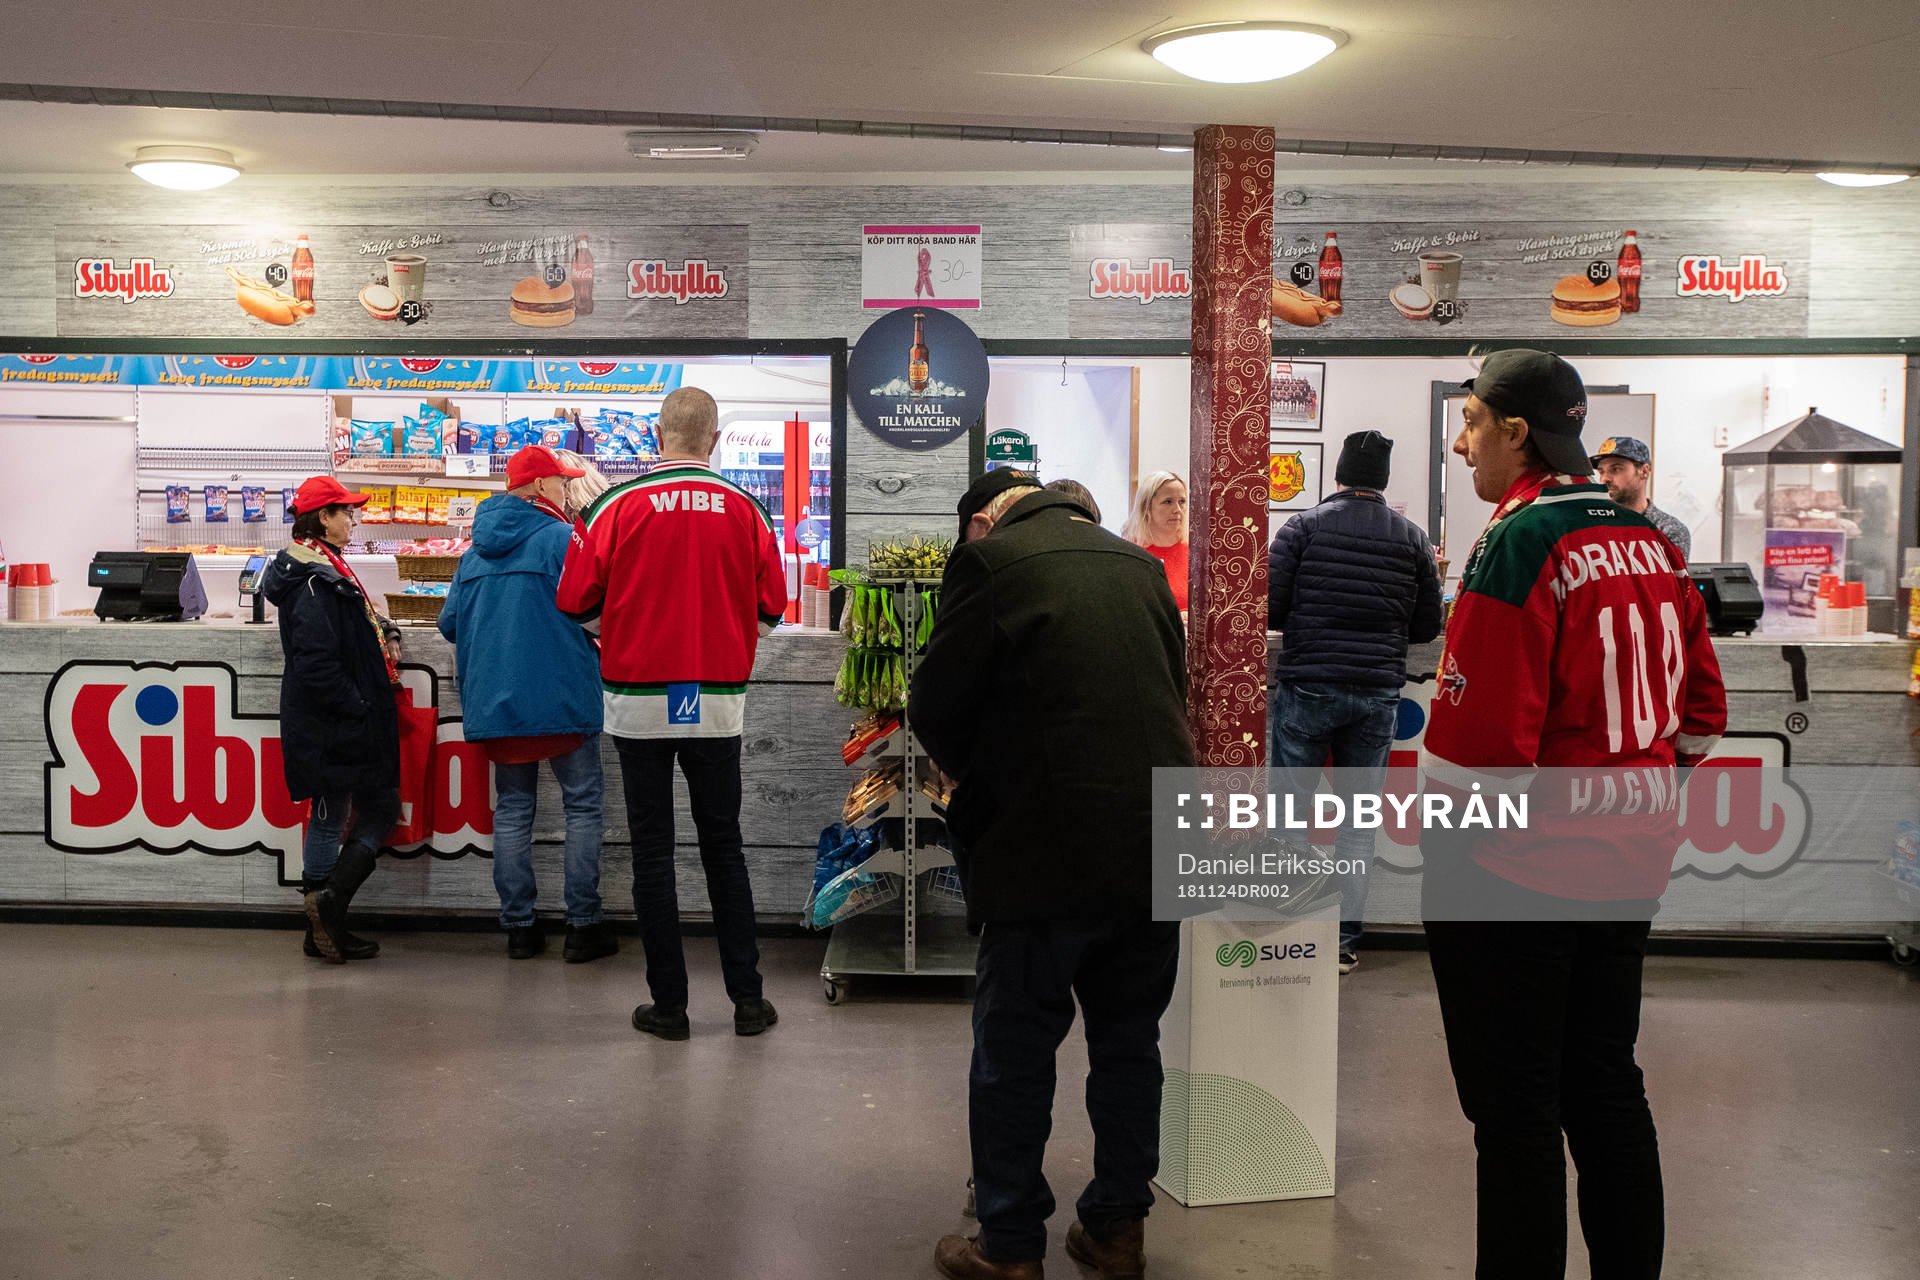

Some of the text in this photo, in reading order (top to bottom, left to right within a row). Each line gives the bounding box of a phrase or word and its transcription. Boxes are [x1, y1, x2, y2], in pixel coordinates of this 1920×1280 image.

[359, 233, 442, 255] Kaffe & Gobit
[477, 233, 574, 255] Hamburgermeny
[867, 235, 976, 245] KÖP DITT ROSA BAND HÄR
[1391, 230, 1480, 253] Kaffe & Gobit
[1517, 229, 1621, 251] Hamburgermeny
[1285, 242, 1318, 259] dryck
[1523, 241, 1614, 263] med 50cl dryck
[484, 256, 507, 267] med
[268, 266, 285, 280] 40
[1294, 266, 1311, 280] 40
[1591, 263, 1609, 278] 60
[1683, 258, 1781, 297] Sibylla
[79, 262, 170, 299] Sibylla
[632, 264, 723, 300] Sibylla
[1095, 263, 1189, 299] Sibylla
[404, 303, 420, 318] 30
[1437, 302, 1454, 317] 30
[1, 367, 118, 384] fredagsmyset!
[200, 373, 310, 387] fredagsmyset!
[386, 377, 491, 391] fredagsmyset!
[564, 380, 665, 394] fredagsmyset!
[896, 404, 944, 414] EN KALL
[878, 416, 960, 426] TILL MATCHEN
[545, 435, 559, 443] OLW
[992, 436, 1024, 446] Läkerol
[399, 492, 424, 502] bilar
[429, 493, 448, 503] bila
[648, 490, 725, 514] WIBE
[1569, 764, 1676, 815] HAGMA
[1260, 943, 1316, 961] suez
